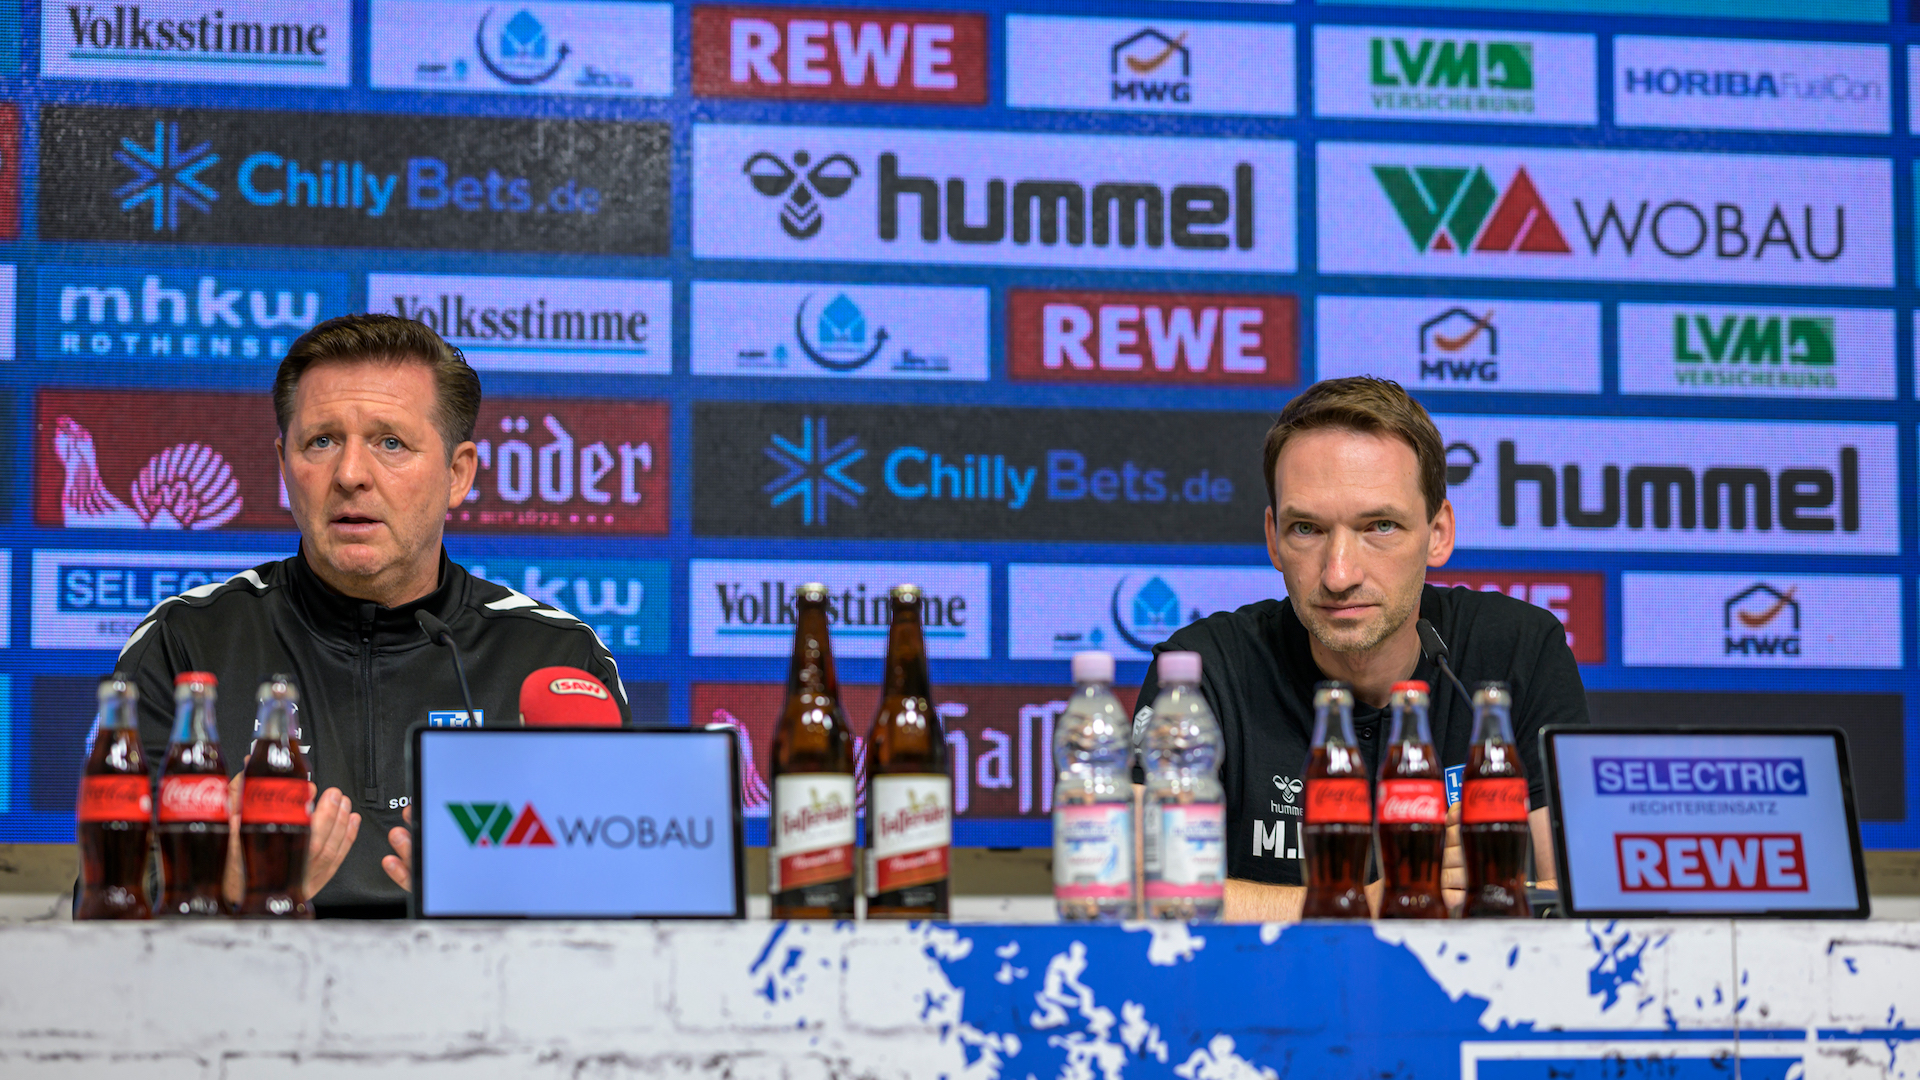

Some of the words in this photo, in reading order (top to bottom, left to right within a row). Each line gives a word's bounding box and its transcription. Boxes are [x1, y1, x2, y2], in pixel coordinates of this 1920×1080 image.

[68, 4, 327, 56] Volksstimme
[729, 17, 959, 91] REWE
[1371, 37, 1480, 89] LVM
[1111, 81, 1190, 103] MWG
[1371, 92, 1536, 114] VERSICHERUNG
[878, 151, 1255, 252] hummel
[1573, 199, 1846, 262] WOBAU
[60, 274, 320, 329] mhkw
[60, 330, 289, 359] ROTHENSE
[1042, 303, 1268, 374] REWE
[1675, 313, 1782, 365] LVM
[1420, 360, 1498, 382] MWG
[1675, 369, 1837, 389] VERSICHERUNG
[1497, 438, 1860, 533] hummel
[1725, 637, 1800, 656] MWG
[1598, 761, 1802, 792] SELECTRIC
[1270, 799, 1304, 817] humme
[1629, 801, 1779, 816] #ECHTEREINSATZ
[556, 815, 714, 849] WOBAU
[1620, 837, 1804, 888] REWE
